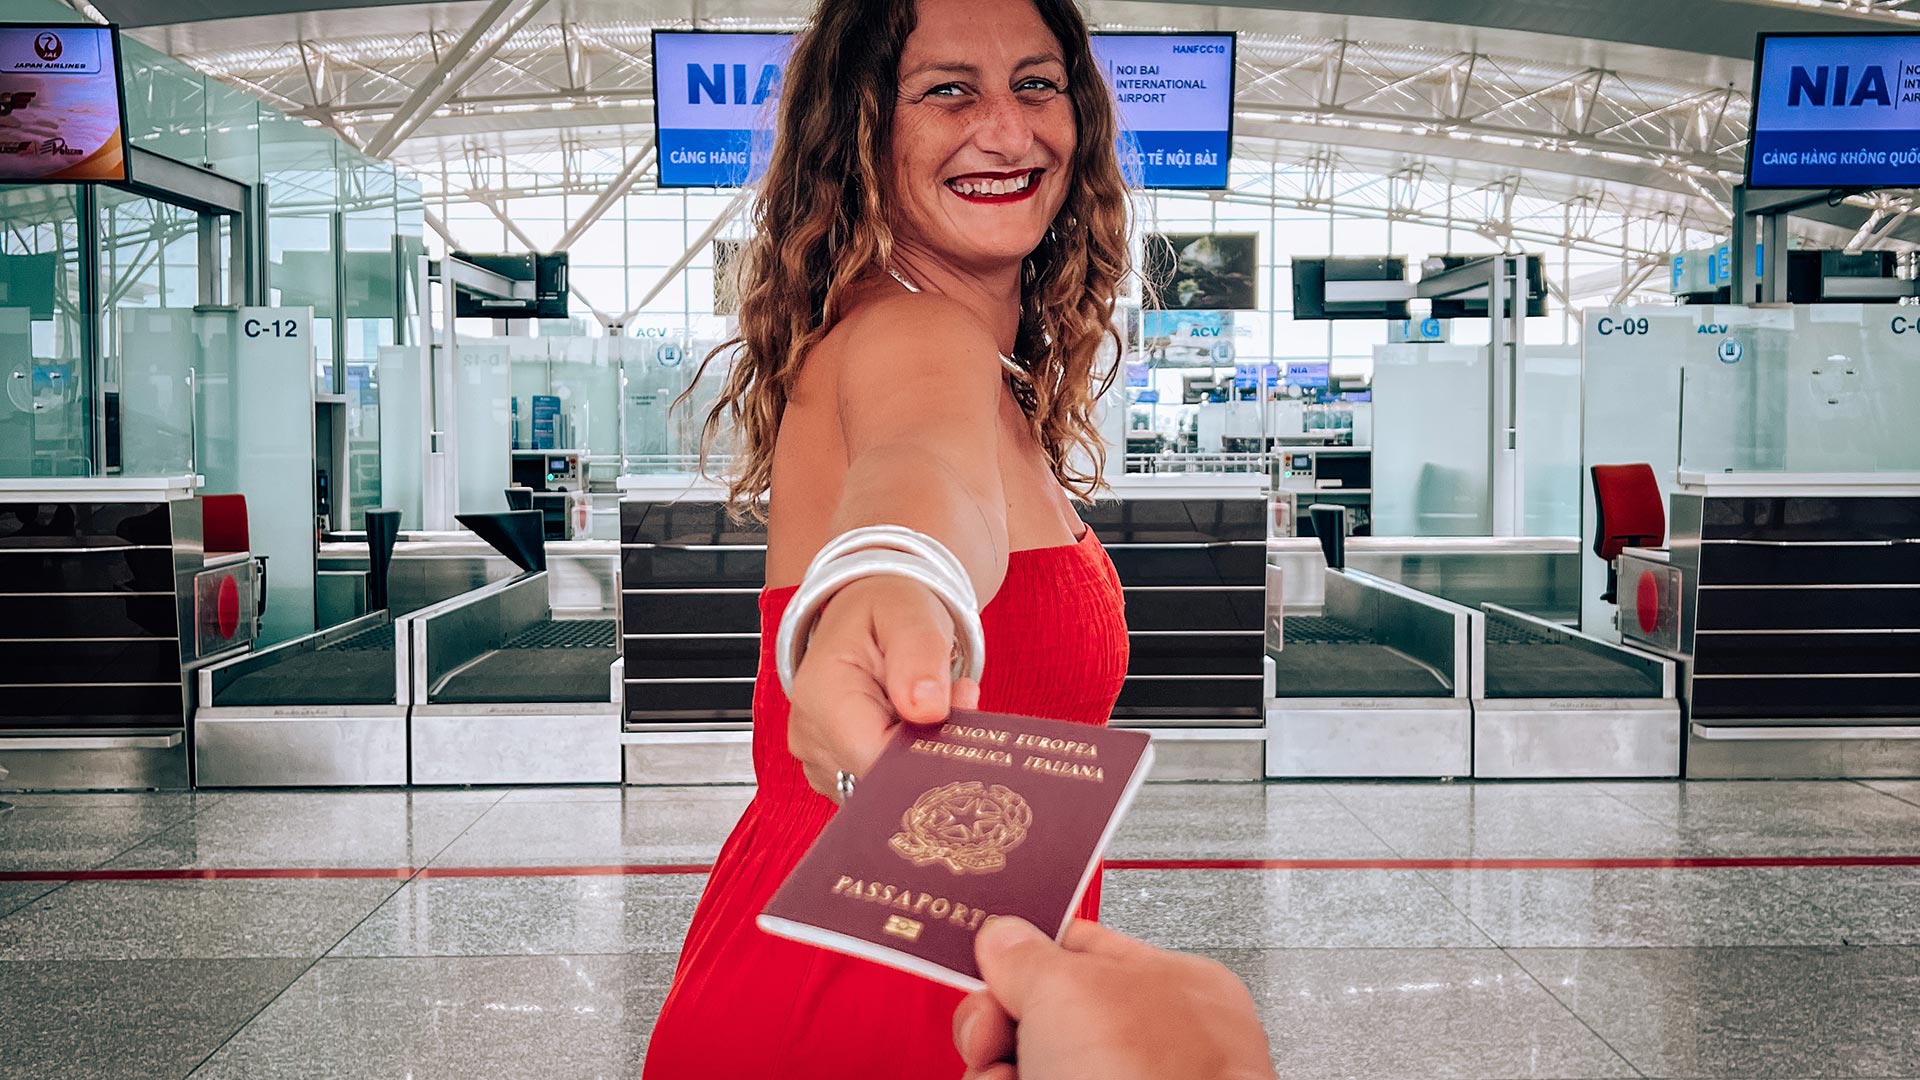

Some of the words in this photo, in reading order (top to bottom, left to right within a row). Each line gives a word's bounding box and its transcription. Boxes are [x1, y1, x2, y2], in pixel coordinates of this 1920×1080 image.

[1172, 45, 1225, 54] HANFCC10
[1116, 65, 1137, 75] NOI
[1140, 65, 1159, 75] BAI
[1116, 79, 1207, 89] INTERNATIONAL
[1787, 65, 1892, 107] NIA
[1117, 93, 1167, 103] AIRPORT
[710, 147, 747, 165] HÀNG
[1166, 149, 1191, 168] NỘI
[1194, 149, 1218, 166] BÀI
[1801, 148, 1837, 165] HÀNG
[1840, 148, 1886, 165] KHÔNG
[244, 319, 298, 338] C-12
[636, 327, 667, 338] ACV
[1190, 327, 1221, 337] ACV
[1420, 318, 1440, 339] G
[1597, 317, 1649, 335] C-09
[1697, 324, 1728, 334] ACV
[940, 723, 1011, 745] UNIONE
[1014, 733, 1098, 757] EUROPEA
[911, 739, 1013, 767] REPUBBLICA
[1023, 755, 1104, 783] ITALIANA
[832, 874, 986, 930] PASSAPORT
